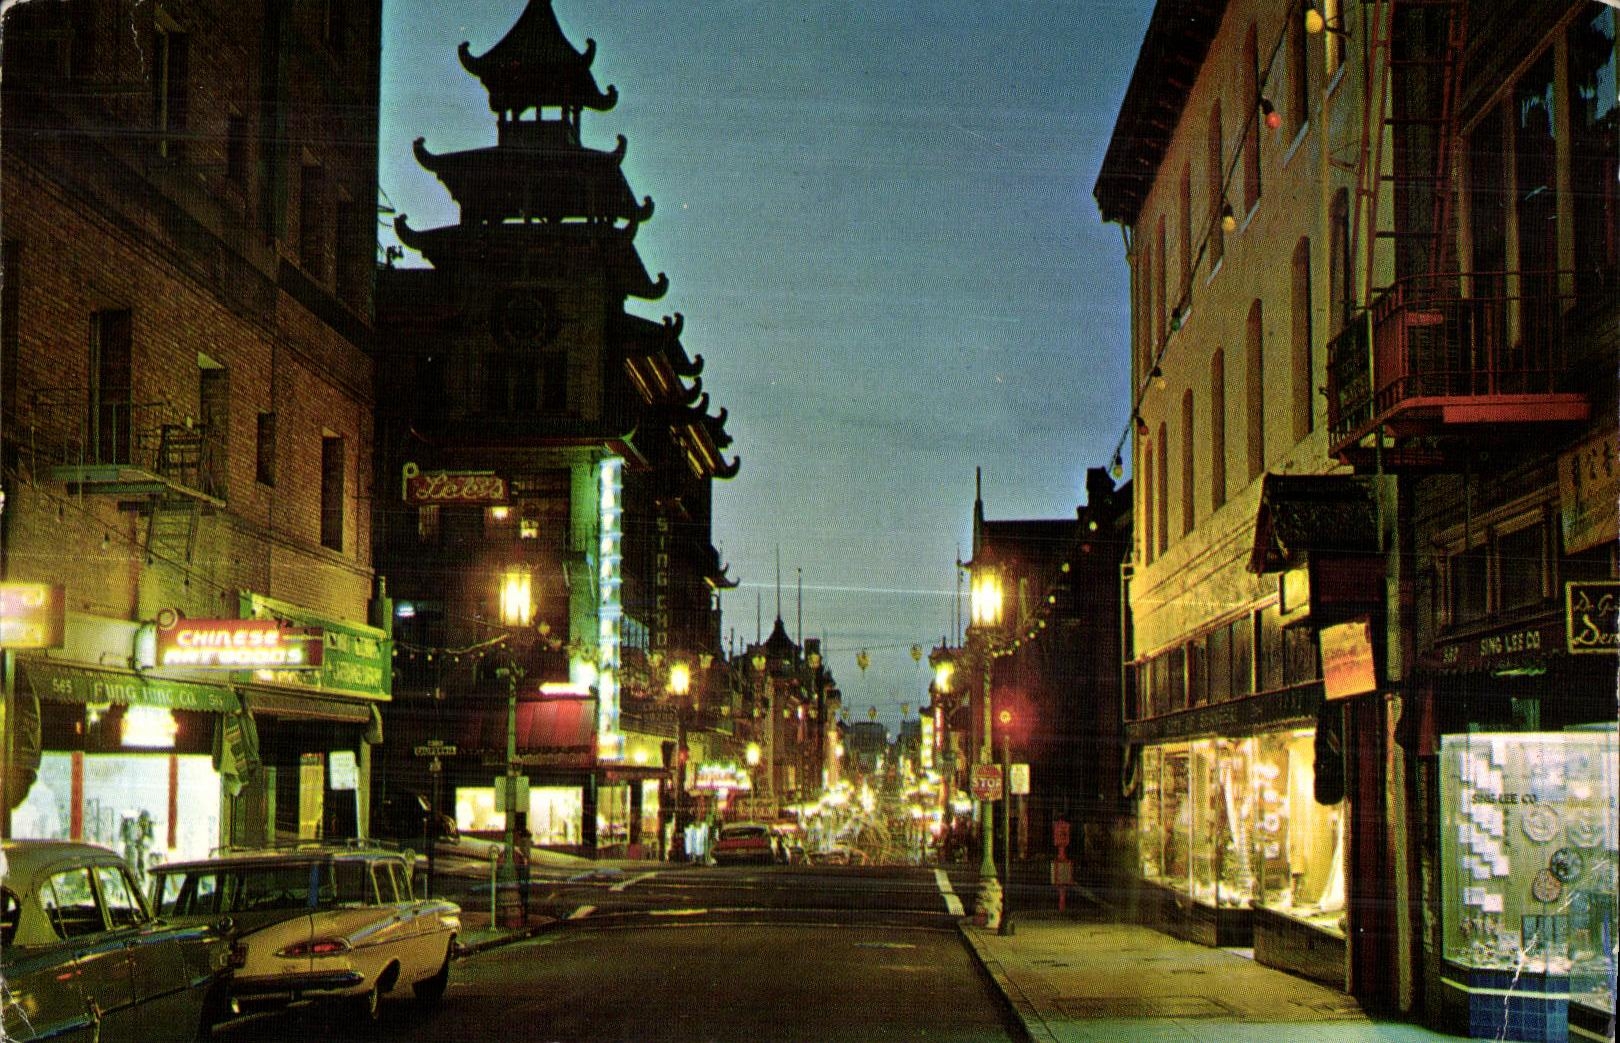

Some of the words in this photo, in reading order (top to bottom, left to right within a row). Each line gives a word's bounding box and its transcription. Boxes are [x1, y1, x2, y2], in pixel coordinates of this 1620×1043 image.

[656, 517, 668, 586] SING
[177, 630, 279, 647] CHINESE
[972, 777, 1002, 788] STOP
[1498, 793, 1518, 804] LEE
